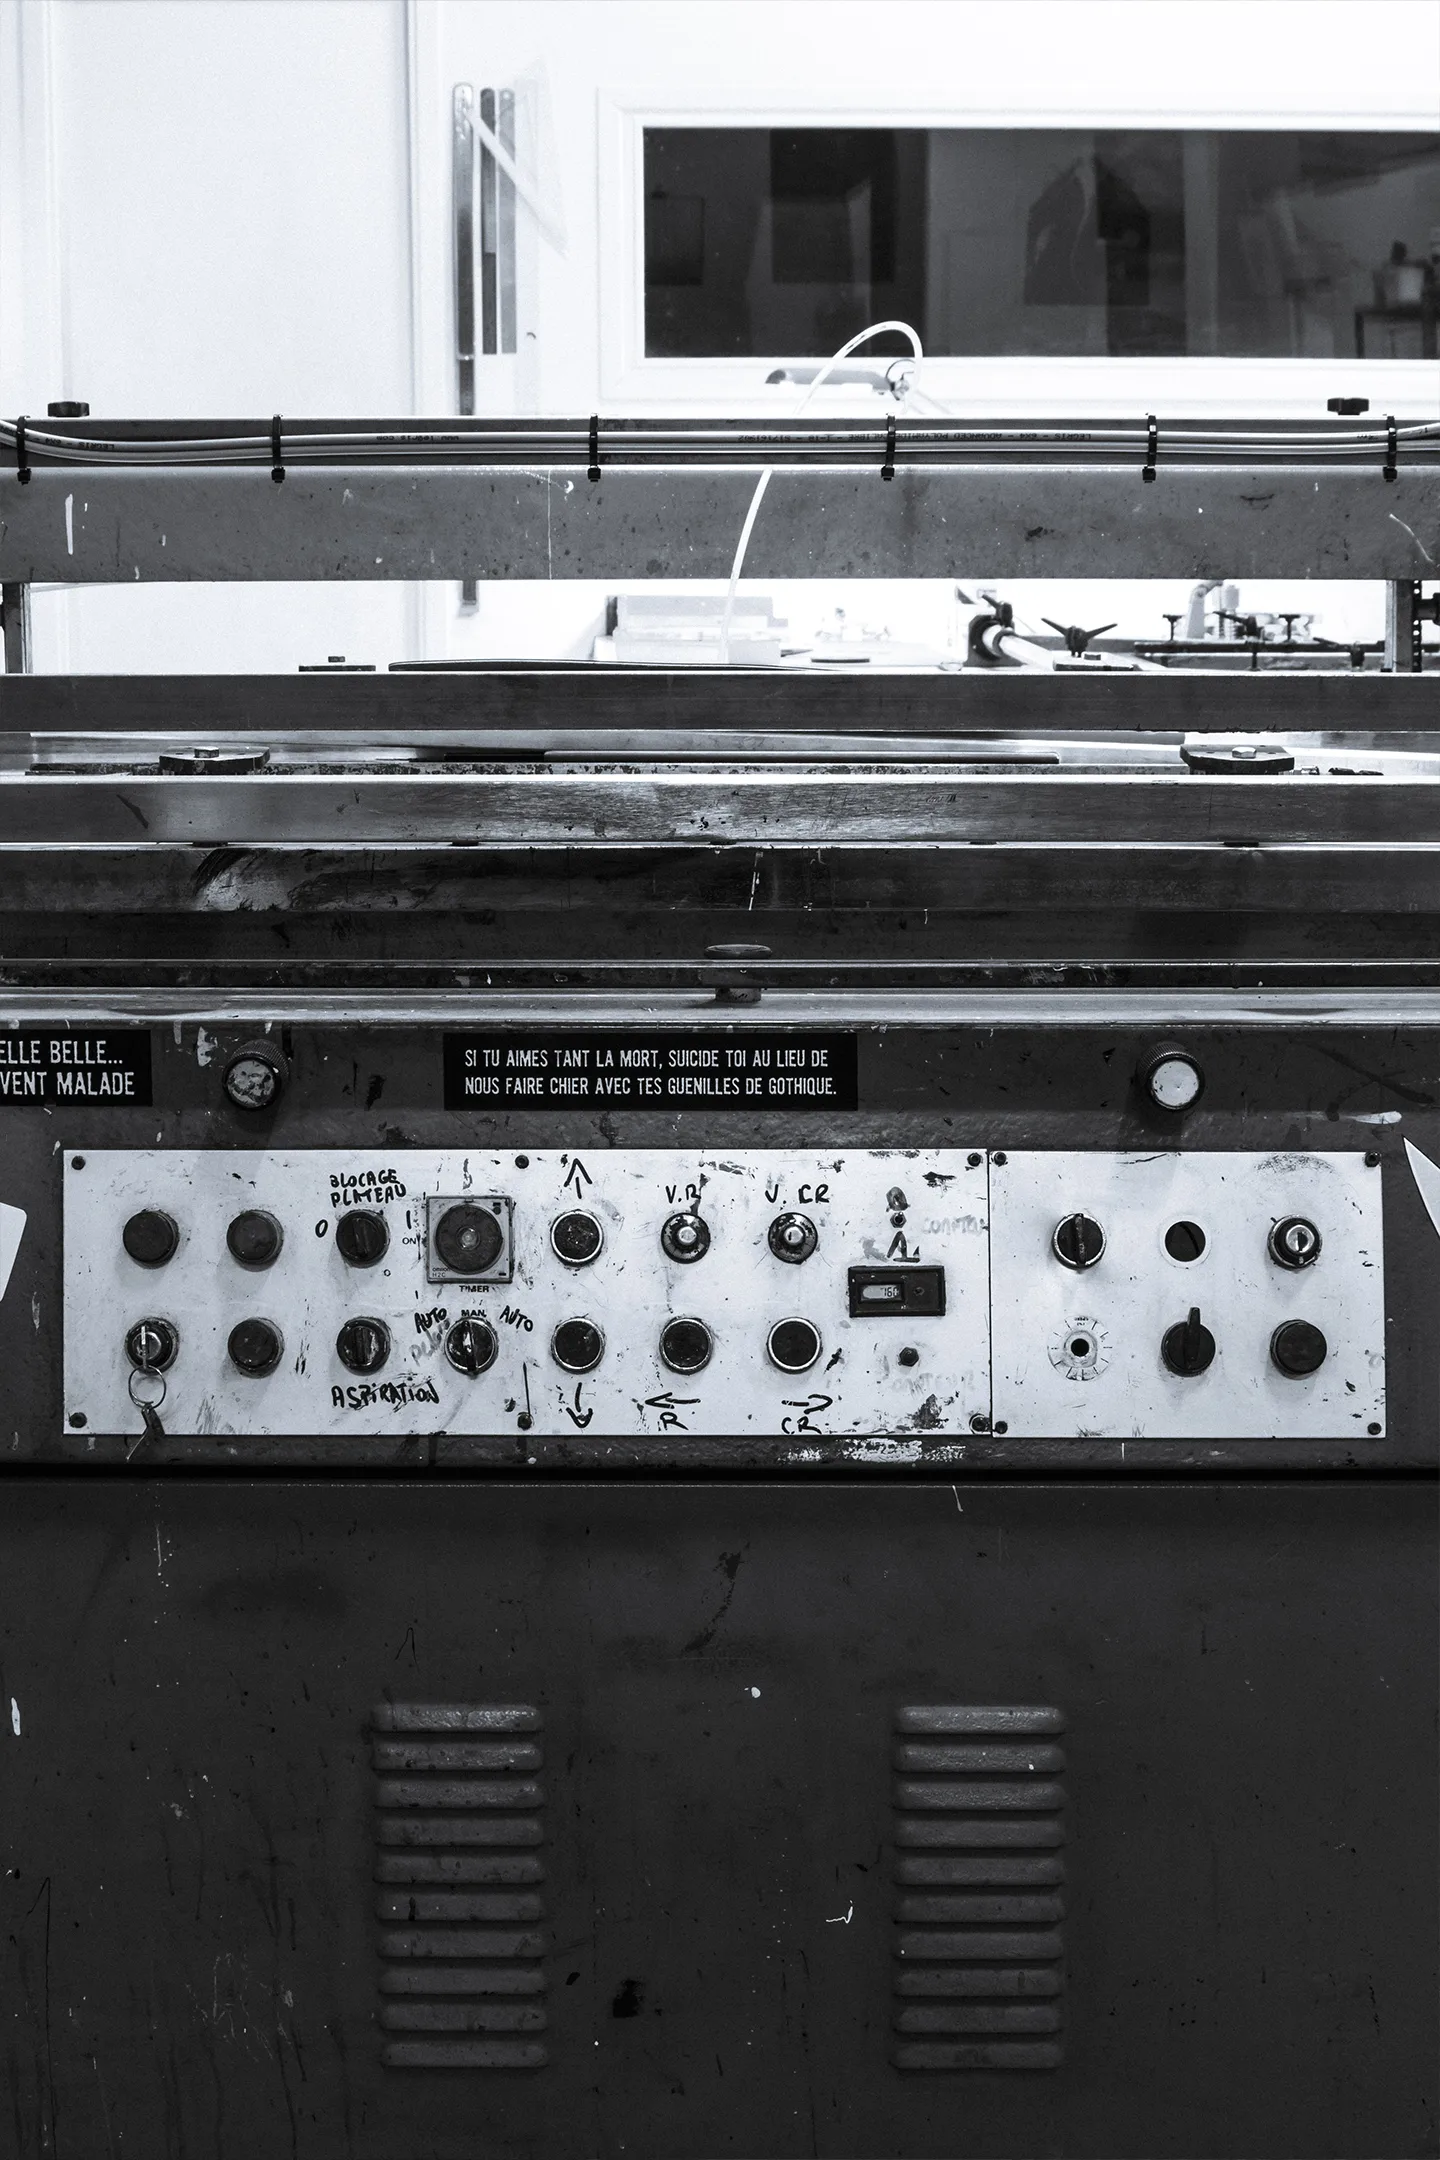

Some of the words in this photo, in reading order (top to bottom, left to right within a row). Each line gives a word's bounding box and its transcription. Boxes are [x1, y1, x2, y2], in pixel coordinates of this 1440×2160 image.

[465, 1049, 476, 1067] SI
[483, 1049, 499, 1067] TU
[506, 1049, 548, 1067] AIMES
[554, 1049, 590, 1067] TANT
[597, 1049, 614, 1067] LA
[620, 1049, 662, 1070] MORT,
[669, 1049, 719, 1067] SUICIDE
[726, 1049, 746, 1067] TOI
[753, 1049, 770, 1067] AU
[777, 1049, 805, 1067] LIEU
[812, 1049, 828, 1067] DE
[57, 1072, 134, 1095] MALADE
[466, 1077, 499, 1095] NOUS
[506, 1077, 543, 1095] FAIRE
[550, 1077, 588, 1095] CHIER
[595, 1077, 630, 1095] AVEC
[637, 1077, 661, 1095] TES
[668, 1077, 739, 1095] GUENILLES
[746, 1077, 762, 1095] DE
[769, 1077, 836, 1095] GOTHIQUE.
[329, 1168, 400, 1188] BLOCAGE
[330, 1183, 407, 1207] PLATEAU
[402, 1237, 417, 1245] ON
[459, 1285, 490, 1293] TIMER
[414, 1307, 448, 1334] AUTO
[499, 1305, 534, 1332] AUTO
[660, 1411, 689, 1431] R
